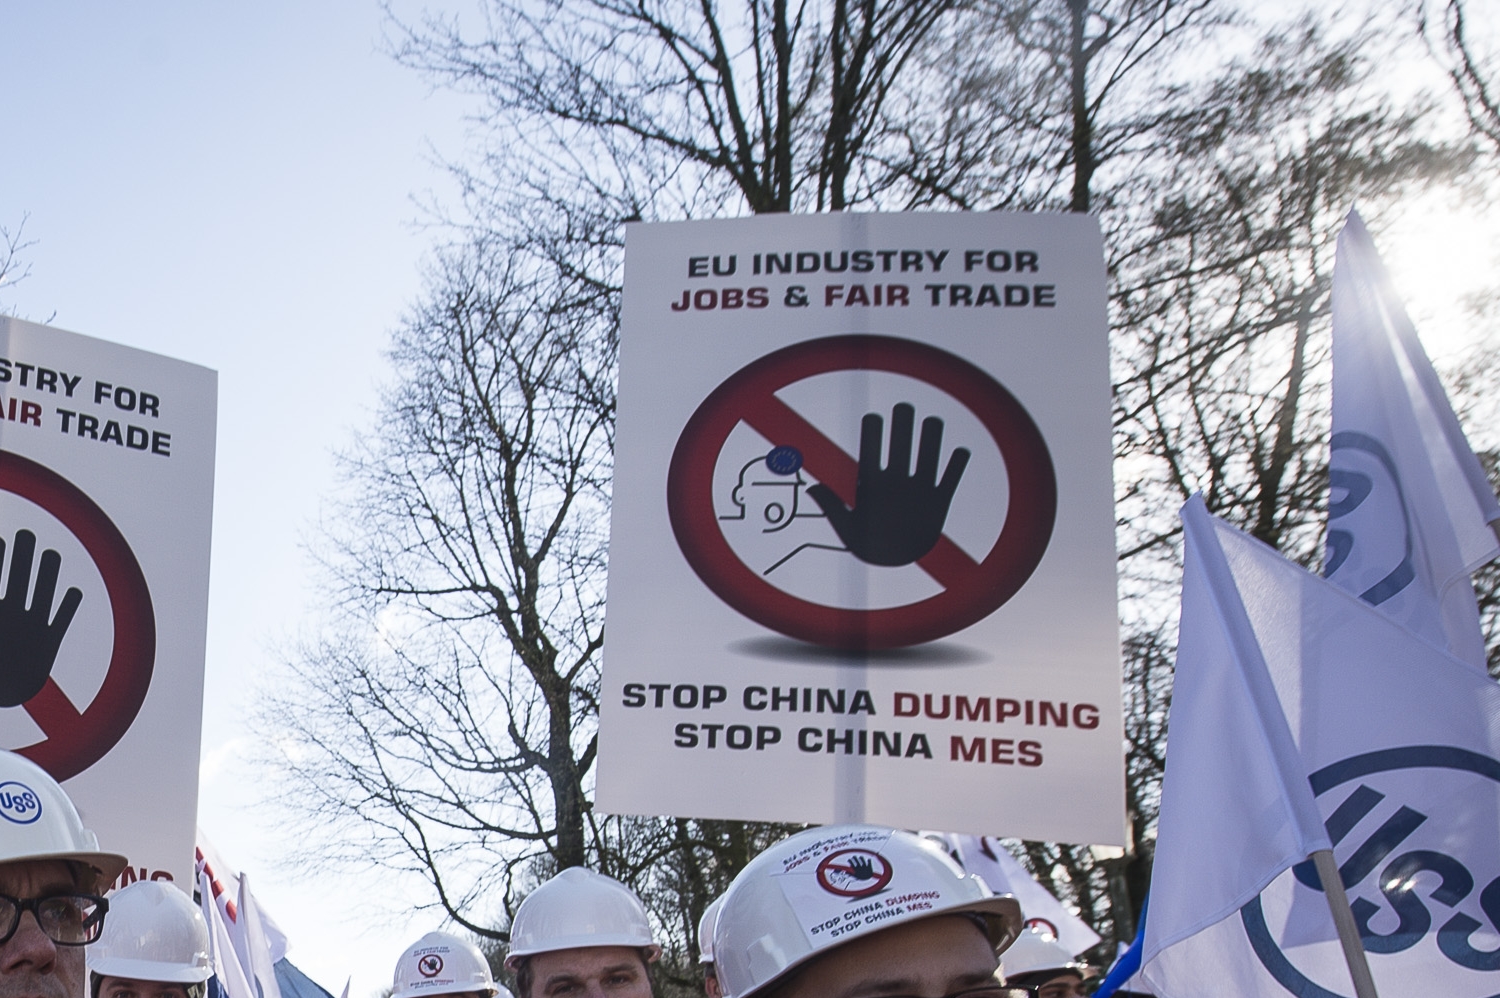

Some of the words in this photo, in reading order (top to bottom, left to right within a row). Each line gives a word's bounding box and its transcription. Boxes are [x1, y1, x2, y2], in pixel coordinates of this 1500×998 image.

[688, 255, 736, 278] EU
[753, 250, 949, 275] INDUSTRY
[965, 251, 1038, 272] FOR
[671, 287, 769, 311] JOBS
[784, 286, 809, 307] &
[825, 285, 909, 306] FAIR
[925, 285, 1055, 307] TRADE
[94, 381, 159, 418] FOR
[56, 408, 171, 457] TRADE
[623, 684, 727, 709] STOP
[743, 686, 876, 715] CHINA
[894, 692, 1099, 729] DUMPING
[675, 723, 781, 750] STOP
[798, 728, 932, 759] CHINA
[951, 736, 1042, 767] MES
[0, 792, 35, 813] USS
[810, 916, 841, 936] STOP
[843, 902, 884, 920] CHINA
[885, 891, 941, 907] DUMPING
[830, 920, 862, 938] STOP
[864, 907, 904, 924] CHINA
[906, 901, 933, 912] MES
